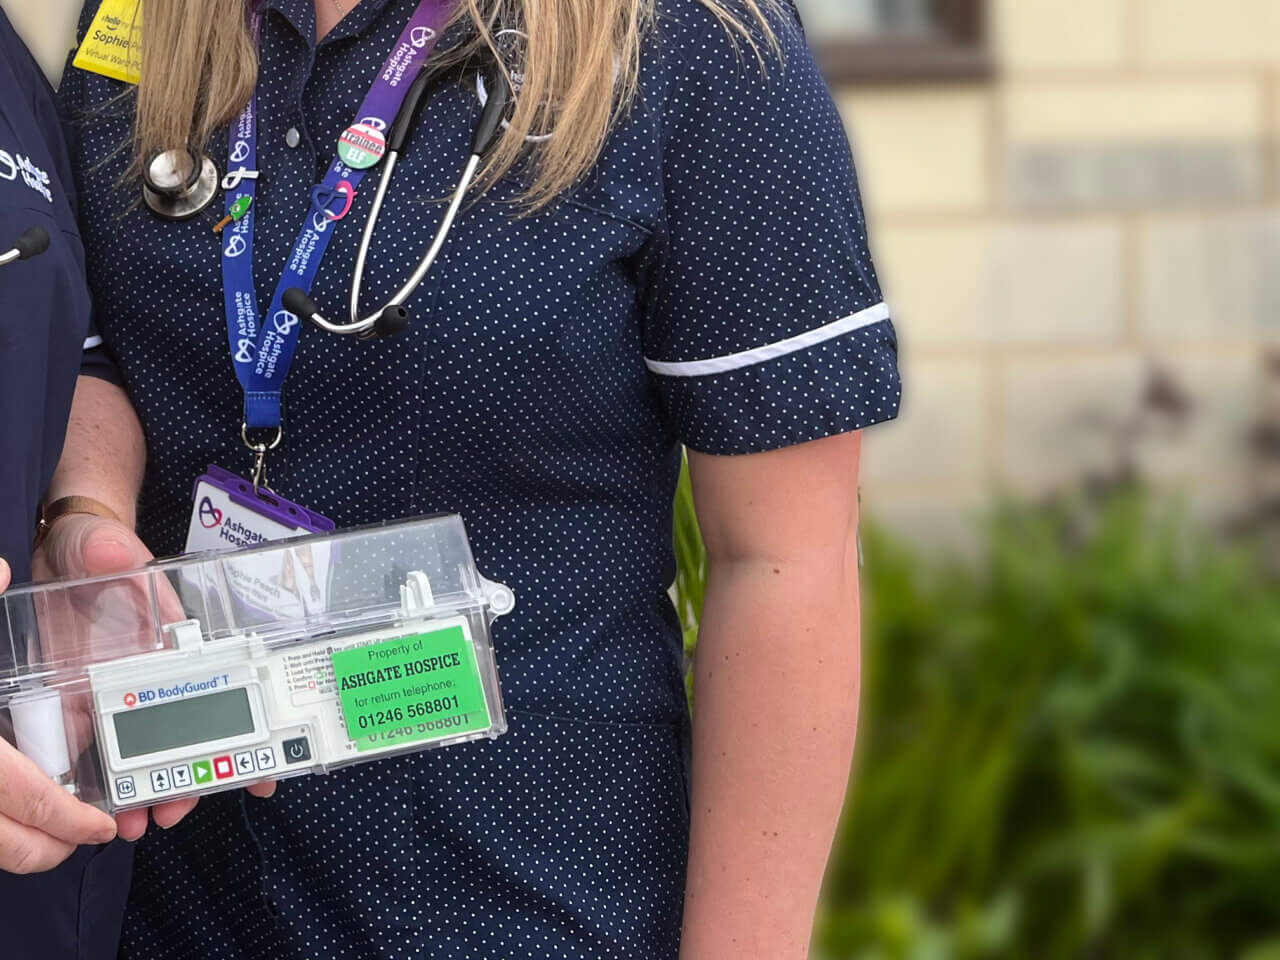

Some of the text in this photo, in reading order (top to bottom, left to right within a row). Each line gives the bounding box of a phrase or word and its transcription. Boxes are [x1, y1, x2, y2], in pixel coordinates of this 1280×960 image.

[93, 29, 129, 49] Sophie
[382, 42, 410, 81] Hospice
[390, 47, 417, 87] Ashgate
[344, 131, 382, 155] Trainee
[347, 147, 367, 163] ELF
[289, 229, 313, 271] Hospice
[297, 233, 320, 276] Ashgate
[235, 291, 247, 336] Ashgate
[244, 292, 256, 338] Hospice
[255, 330, 276, 375] Hospice
[264, 335, 284, 379] Ashgate
[367, 644, 410, 661] Property
[413, 639, 423, 651] of
[137, 690, 156, 702] BD
[221, 674, 229, 686] T
[340, 665, 403, 691] ASHGATE
[404, 652, 461, 677] HOSPICE
[354, 697, 368, 708] for
[371, 691, 401, 704] return
[358, 707, 404, 729] 01246
[407, 695, 460, 718] 568801
